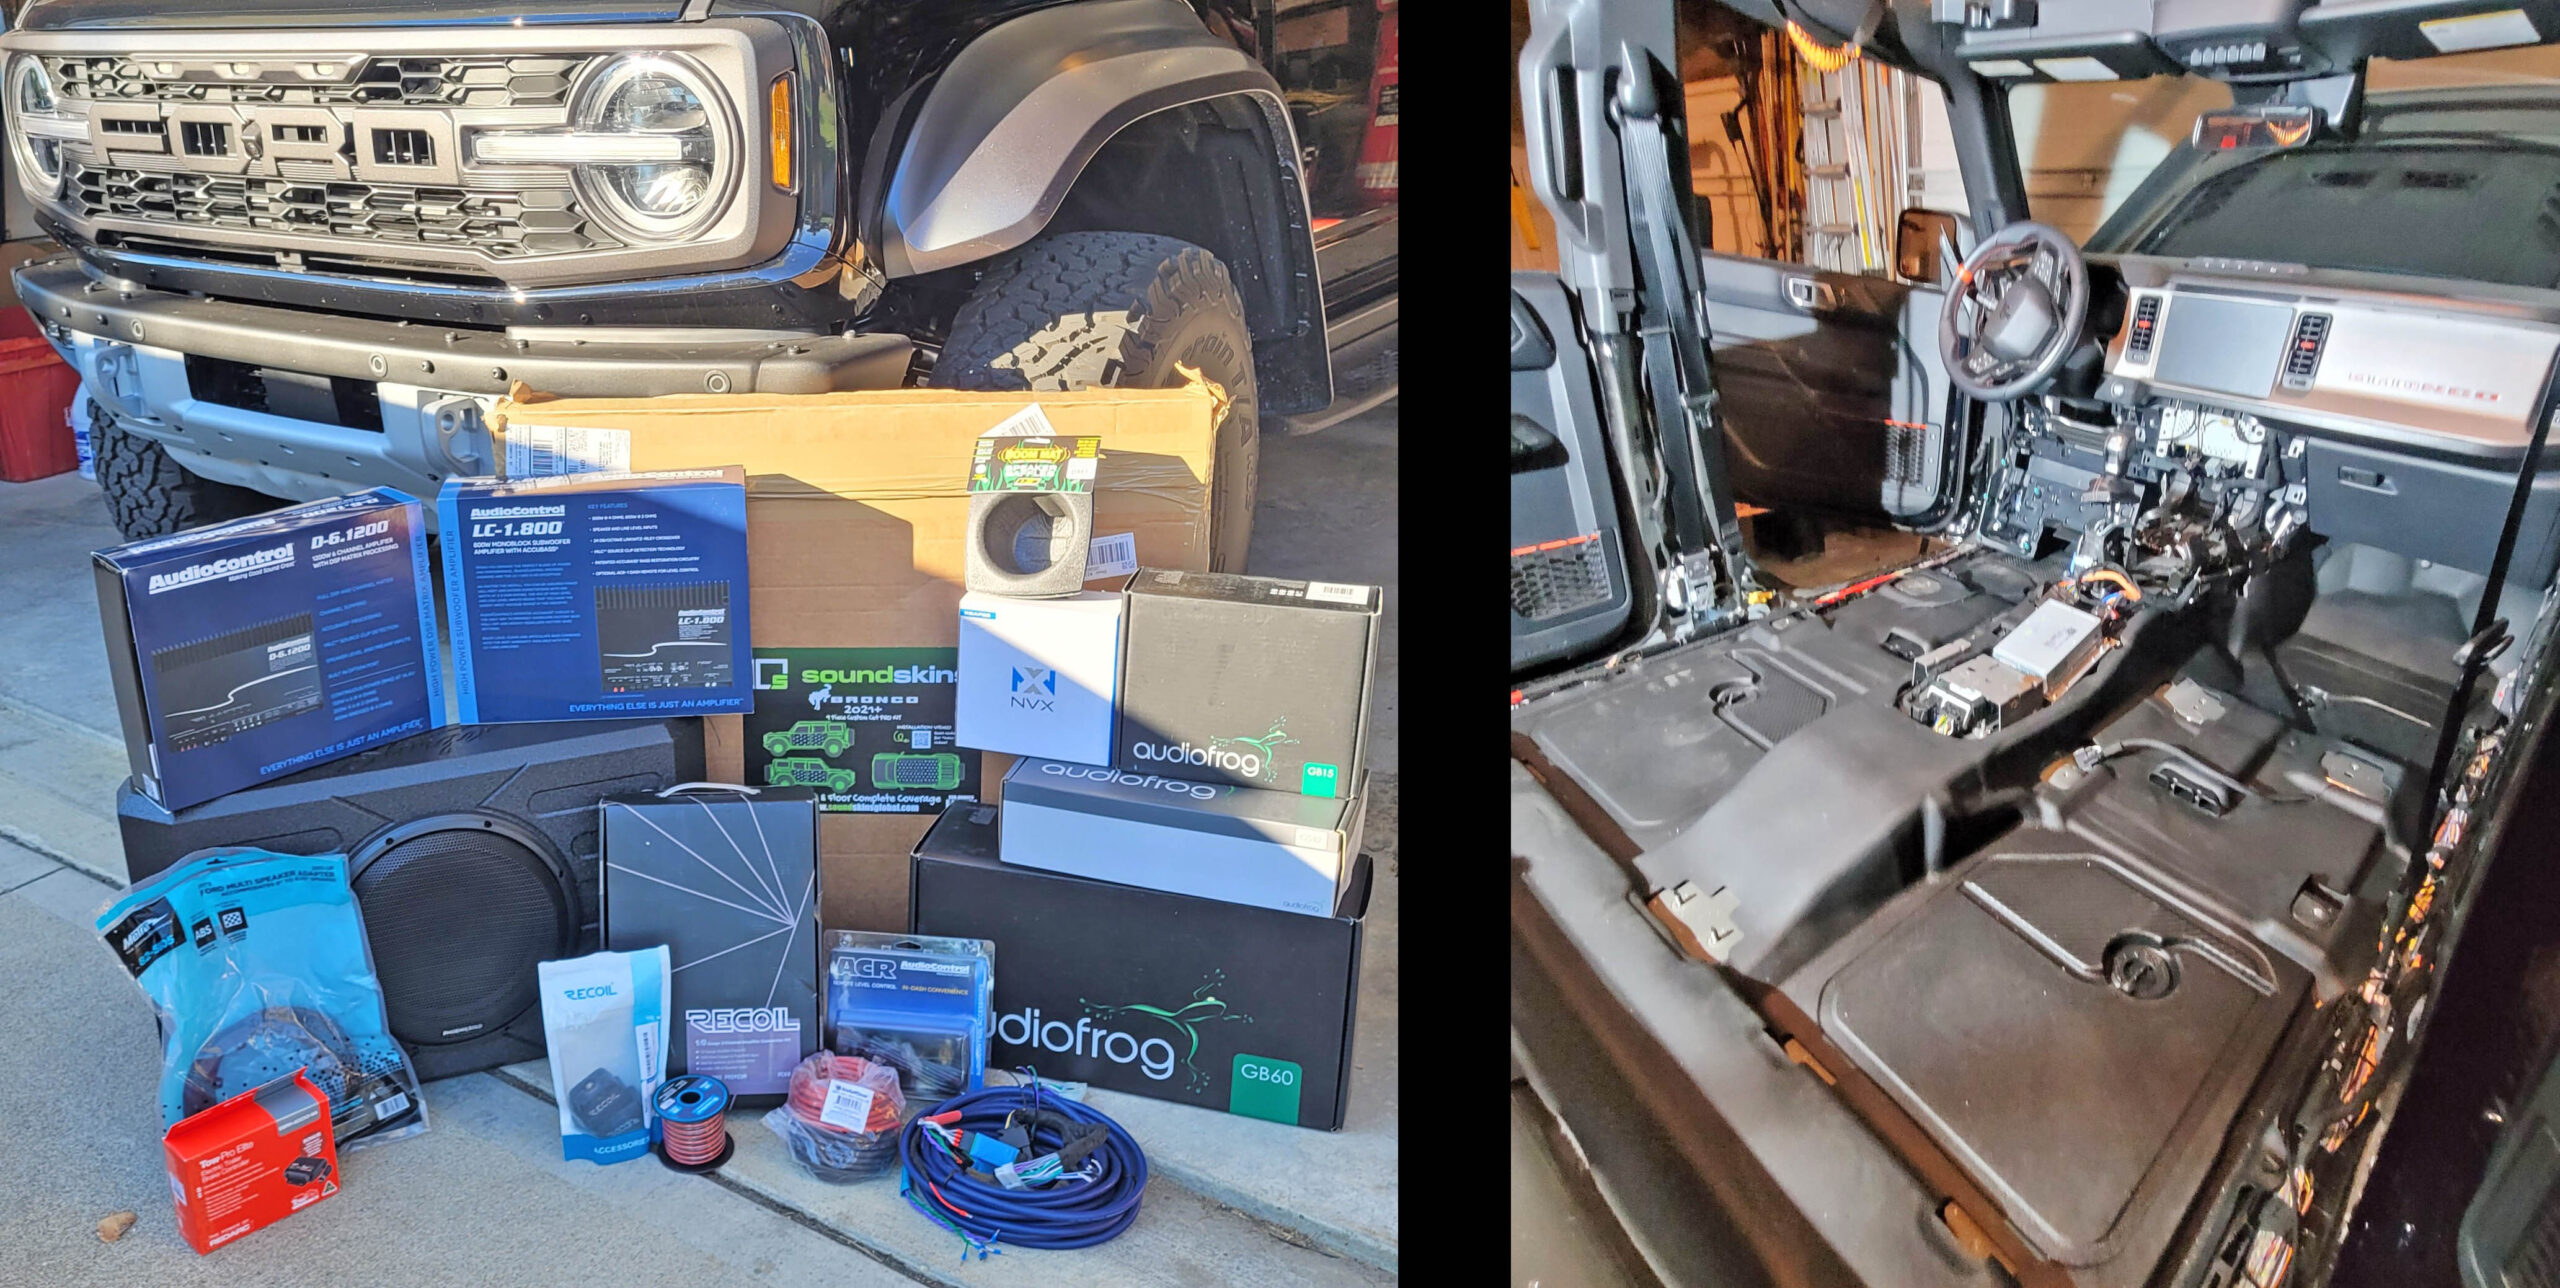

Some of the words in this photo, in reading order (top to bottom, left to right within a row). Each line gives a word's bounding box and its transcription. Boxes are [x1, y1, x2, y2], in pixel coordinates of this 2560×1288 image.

[90, 103, 463, 187] FORD
[1182, 332, 1235, 367] errain
[470, 505, 565, 520] AudioControl
[311, 519, 389, 550] D-6.1200
[472, 521, 564, 538] LC-1.800
[491, 540, 531, 548] MONOBLOCK
[532, 538, 571, 546] SUBWOOFER
[149, 543, 295, 590] AudioControl
[569, 703, 625, 713] EVERYTHING
[626, 702, 647, 710] ELSE
[648, 701, 657, 709] IS
[658, 700, 679, 709] JUST
[681, 700, 695, 708] AN
[696, 698, 741, 708] AMPLIFIER
[843, 705, 883, 715] 2021+
[1010, 697, 1054, 712] NVX
[260, 751, 314, 775] EVERYTHING
[315, 745, 335, 758] ELSE
[336, 742, 344, 751] IS
[346, 736, 365, 749] JUST
[367, 732, 379, 743] AN
[380, 719, 422, 738] AMPLIFIER
[1132, 739, 1260, 778] audiofrog
[1041, 761, 1217, 801] audiofrog
[1307, 767, 1335, 780] GB15
[828, 793, 851, 803] Floor
[852, 793, 894, 805] Complete
[897, 793, 942, 806] Coverage
[819, 803, 920, 813] w.soundskinsglobal.com
[254, 870, 296, 885] SPEAKER
[195, 925, 212, 939] ABS
[837, 956, 897, 980] ACR
[900, 960, 970, 975] AudioControl
[564, 986, 617, 1000] RECOIL
[871, 982, 897, 990] CONTROL
[686, 1006, 800, 1033] RECOIL
[986, 1006, 1176, 1081] diofrog
[1240, 1063, 1294, 1087] GB60
